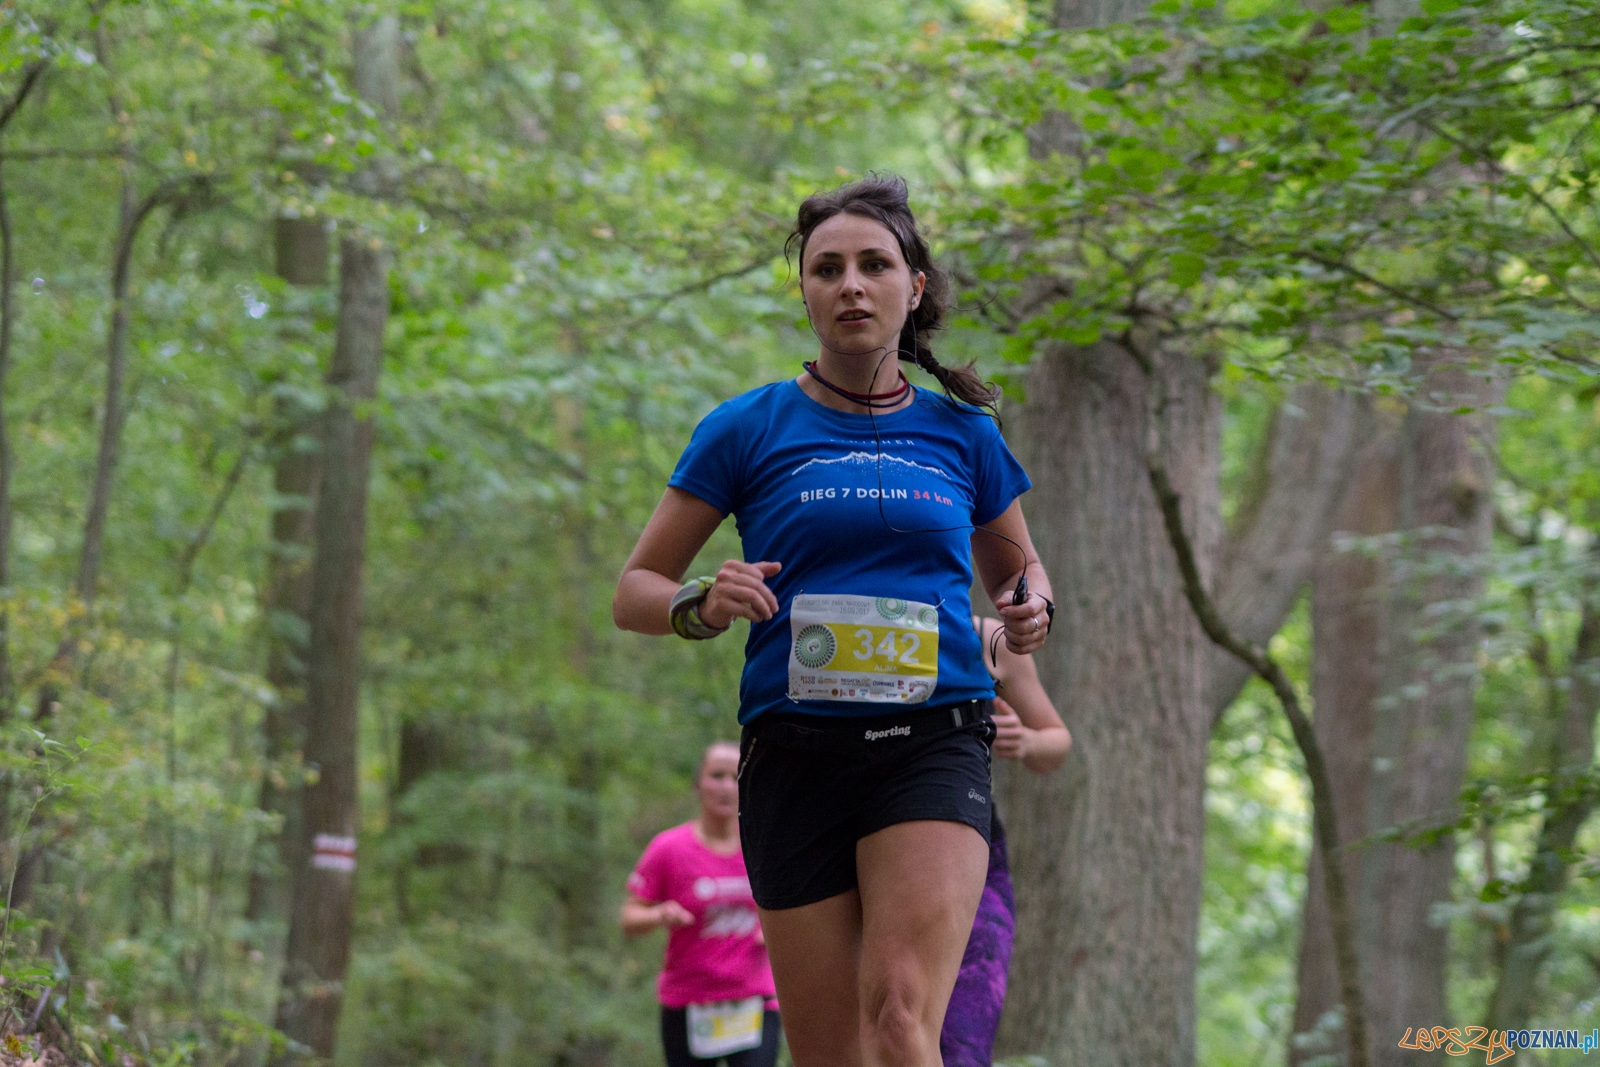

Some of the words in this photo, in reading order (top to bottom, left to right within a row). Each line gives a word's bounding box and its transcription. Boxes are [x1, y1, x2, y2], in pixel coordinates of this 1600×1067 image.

[800, 487, 836, 503] BIEG
[841, 487, 851, 498] 7
[856, 487, 908, 499] DOLIN
[912, 489, 931, 501] 34
[933, 491, 953, 507] km
[853, 628, 920, 664] 342
[874, 664, 898, 673] ALINA
[864, 725, 911, 740] Sporting
